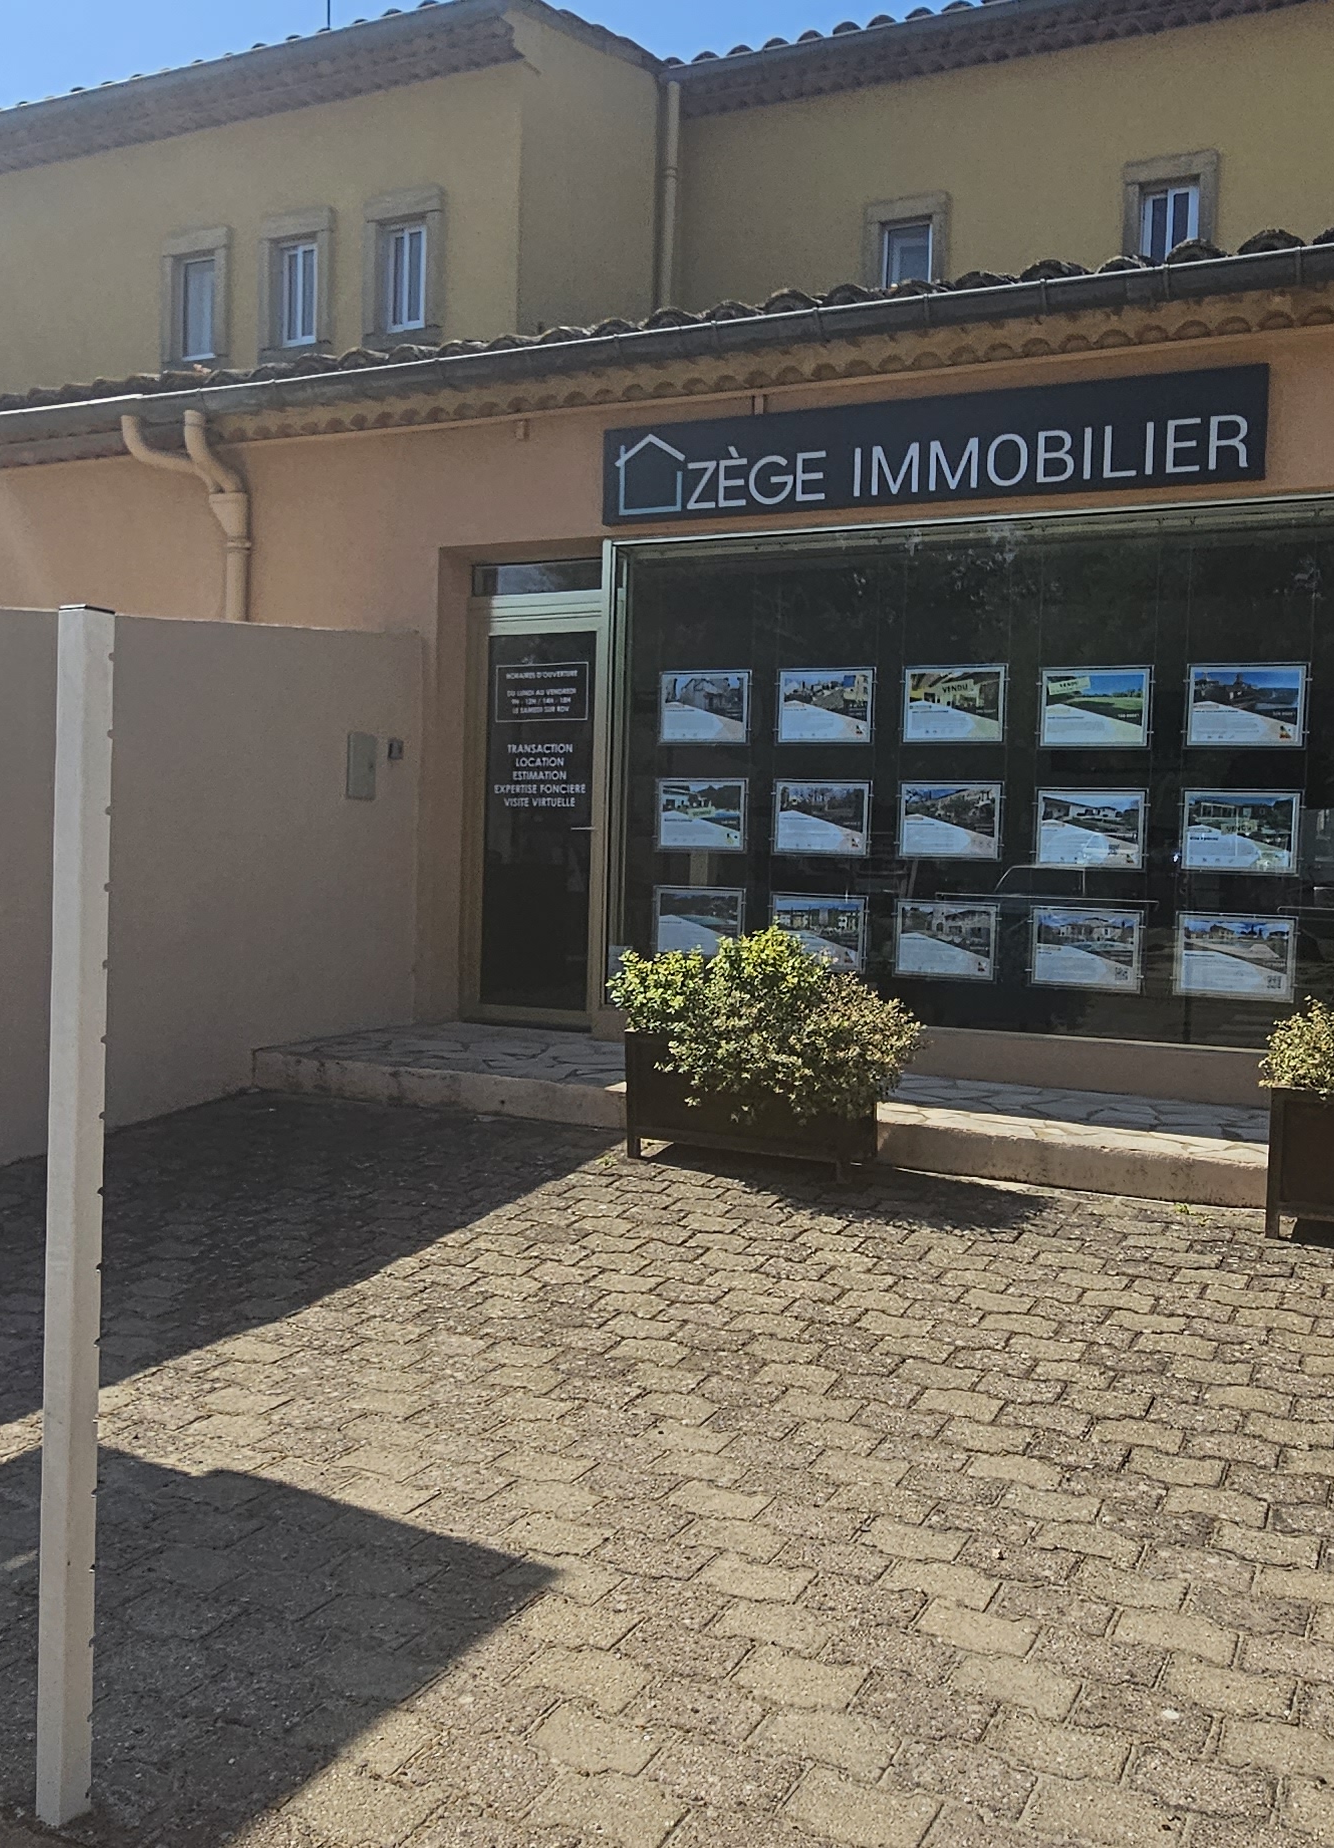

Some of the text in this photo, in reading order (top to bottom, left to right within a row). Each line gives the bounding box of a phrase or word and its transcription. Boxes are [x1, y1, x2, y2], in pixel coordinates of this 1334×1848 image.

[853, 413, 1250, 498] IMMOBILIER
[942, 683, 968, 693] VENDU
[507, 743, 573, 753] TRANSACTION
[515, 757, 564, 767] LOCATION
[512, 771, 567, 780] ESTIMATION
[494, 784, 537, 794] EXPERTISE
[504, 797, 575, 807] VISITE VIRTUELLE
